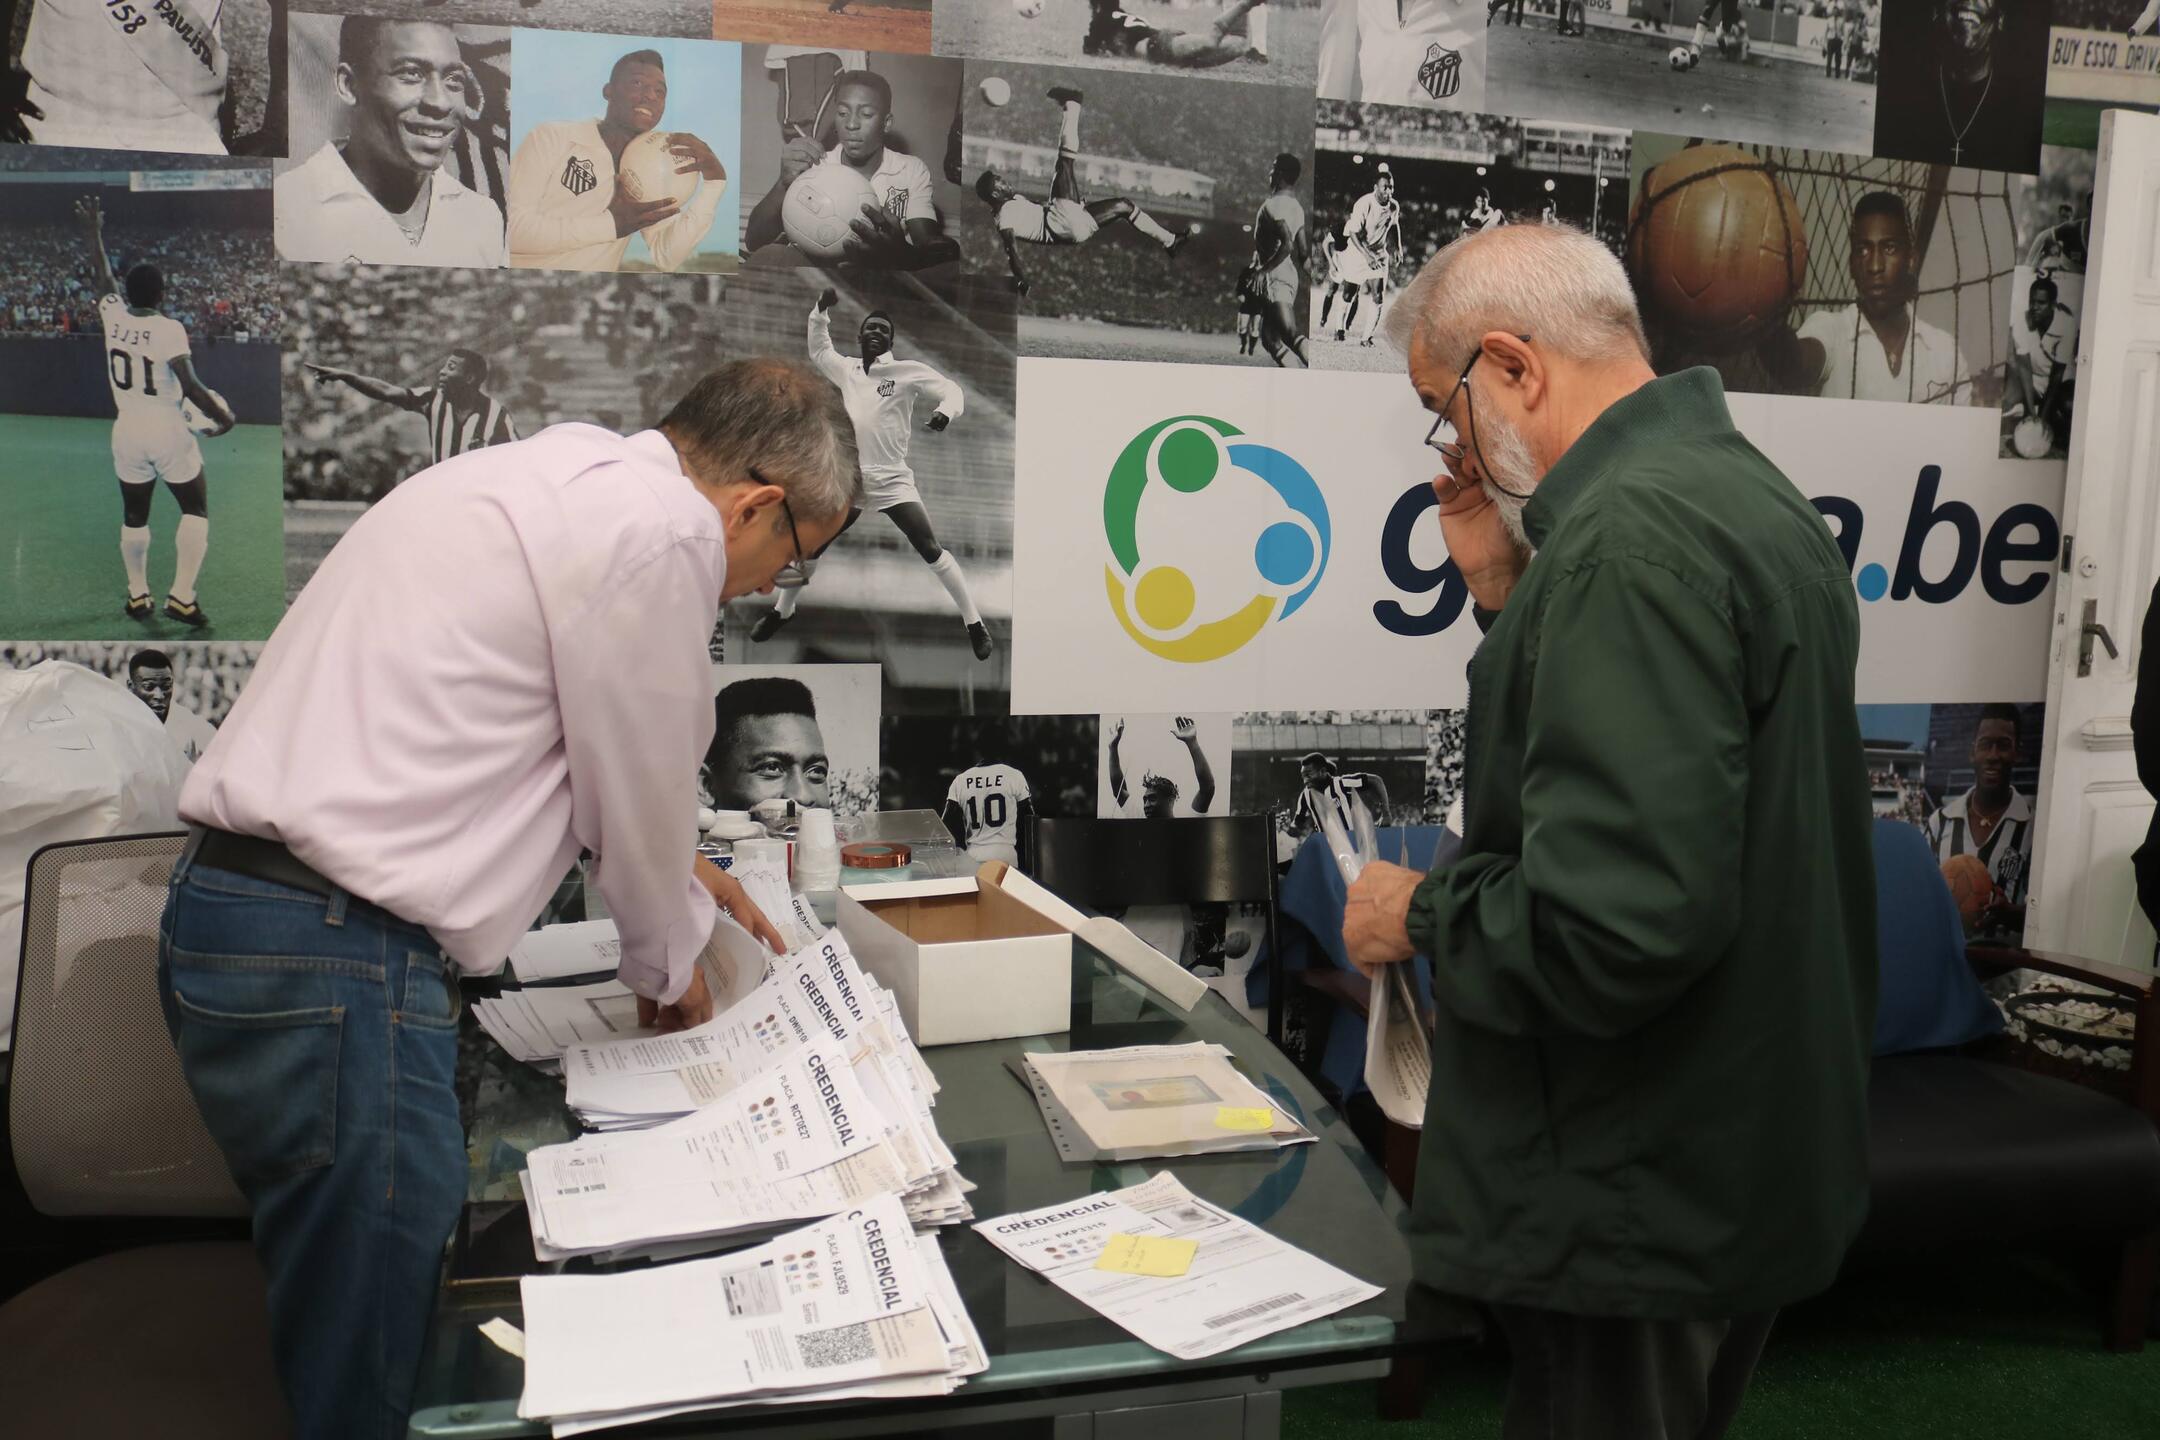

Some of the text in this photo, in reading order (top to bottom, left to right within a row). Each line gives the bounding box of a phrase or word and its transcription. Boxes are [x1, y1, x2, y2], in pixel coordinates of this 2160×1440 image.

[2052, 37, 2081, 65] BUY
[2083, 40, 2118, 68] ESSO
[966, 775, 1003, 789] PELE
[967, 793, 1006, 829] 10
[808, 1054, 856, 1147] CREDENCIAL
[995, 1200, 1118, 1235] CREDENCIAL
[863, 1219, 903, 1309] CREDENCIAL
